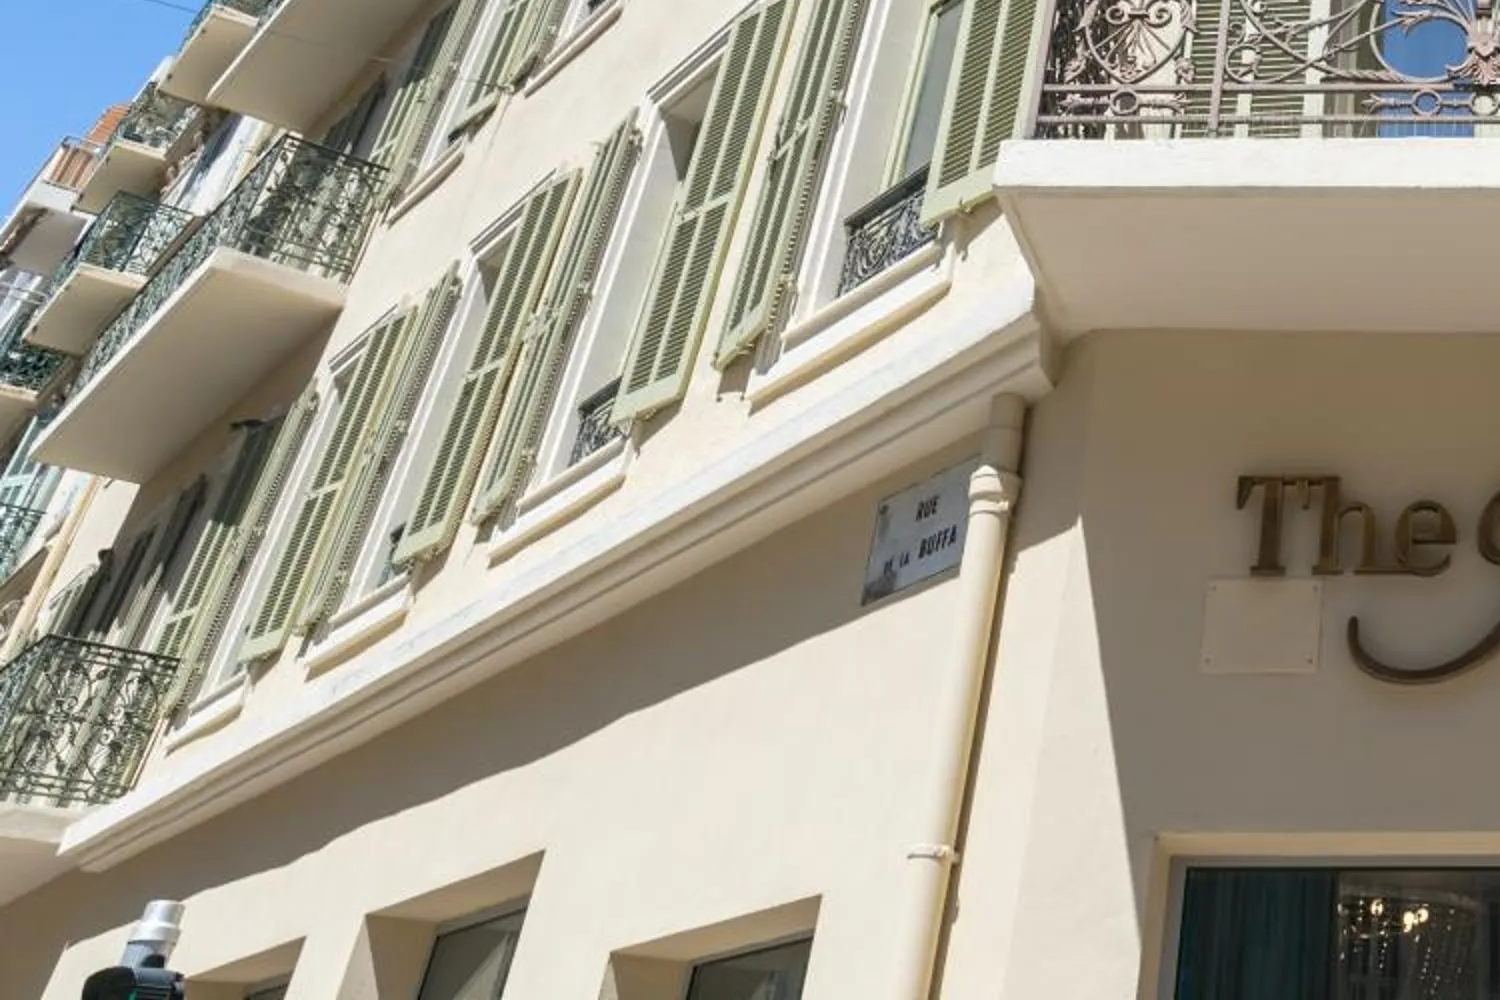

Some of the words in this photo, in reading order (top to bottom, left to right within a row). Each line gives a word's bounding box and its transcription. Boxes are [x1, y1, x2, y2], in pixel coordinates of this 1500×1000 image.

[916, 495, 940, 521] RUE
[1236, 475, 1457, 577] The
[900, 552, 909, 568] LA
[918, 524, 957, 559] BUFFA
